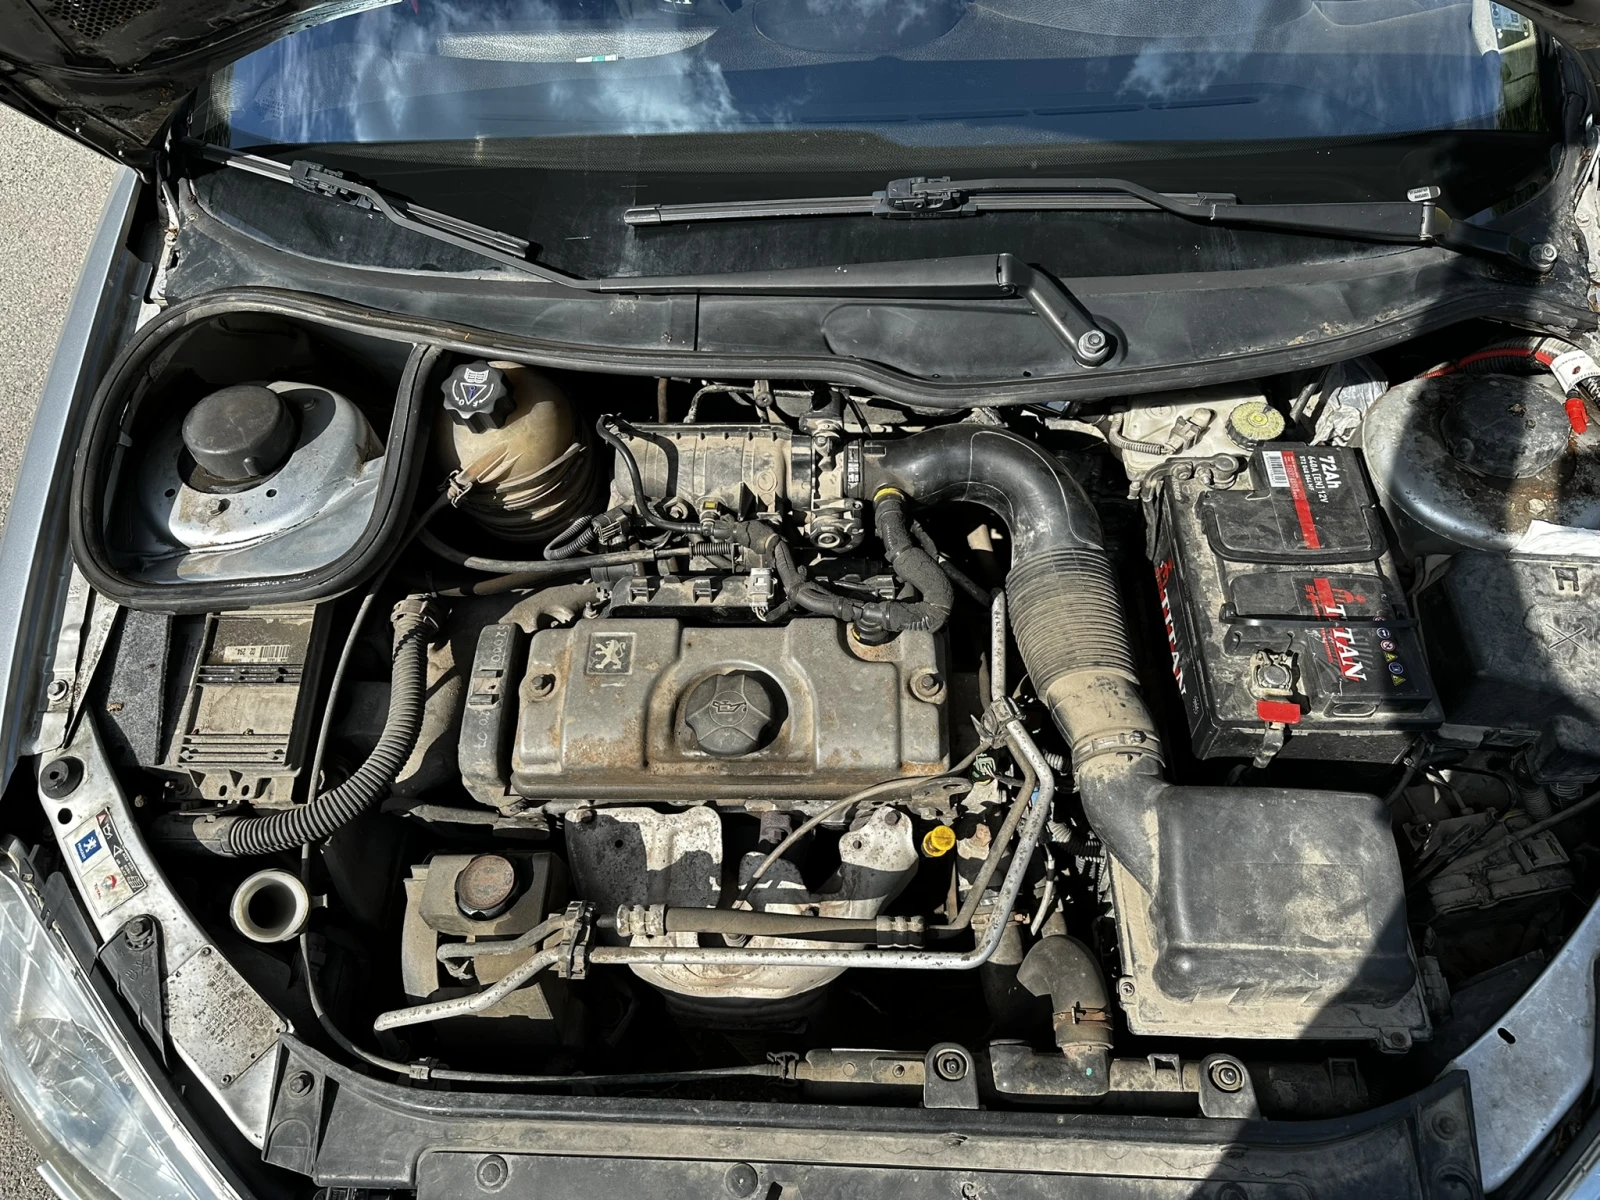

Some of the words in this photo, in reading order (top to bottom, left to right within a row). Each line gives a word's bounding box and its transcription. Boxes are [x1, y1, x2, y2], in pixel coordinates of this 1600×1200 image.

[1307, 455, 1319, 473] 640A
[1318, 490, 1330, 504] 12V
[1319, 455, 1341, 490] 72Ah
[1325, 604, 1367, 681] TTAN
[77, 842, 86, 860] PEUGEOT
[94, 882, 102, 900] TOTAL
